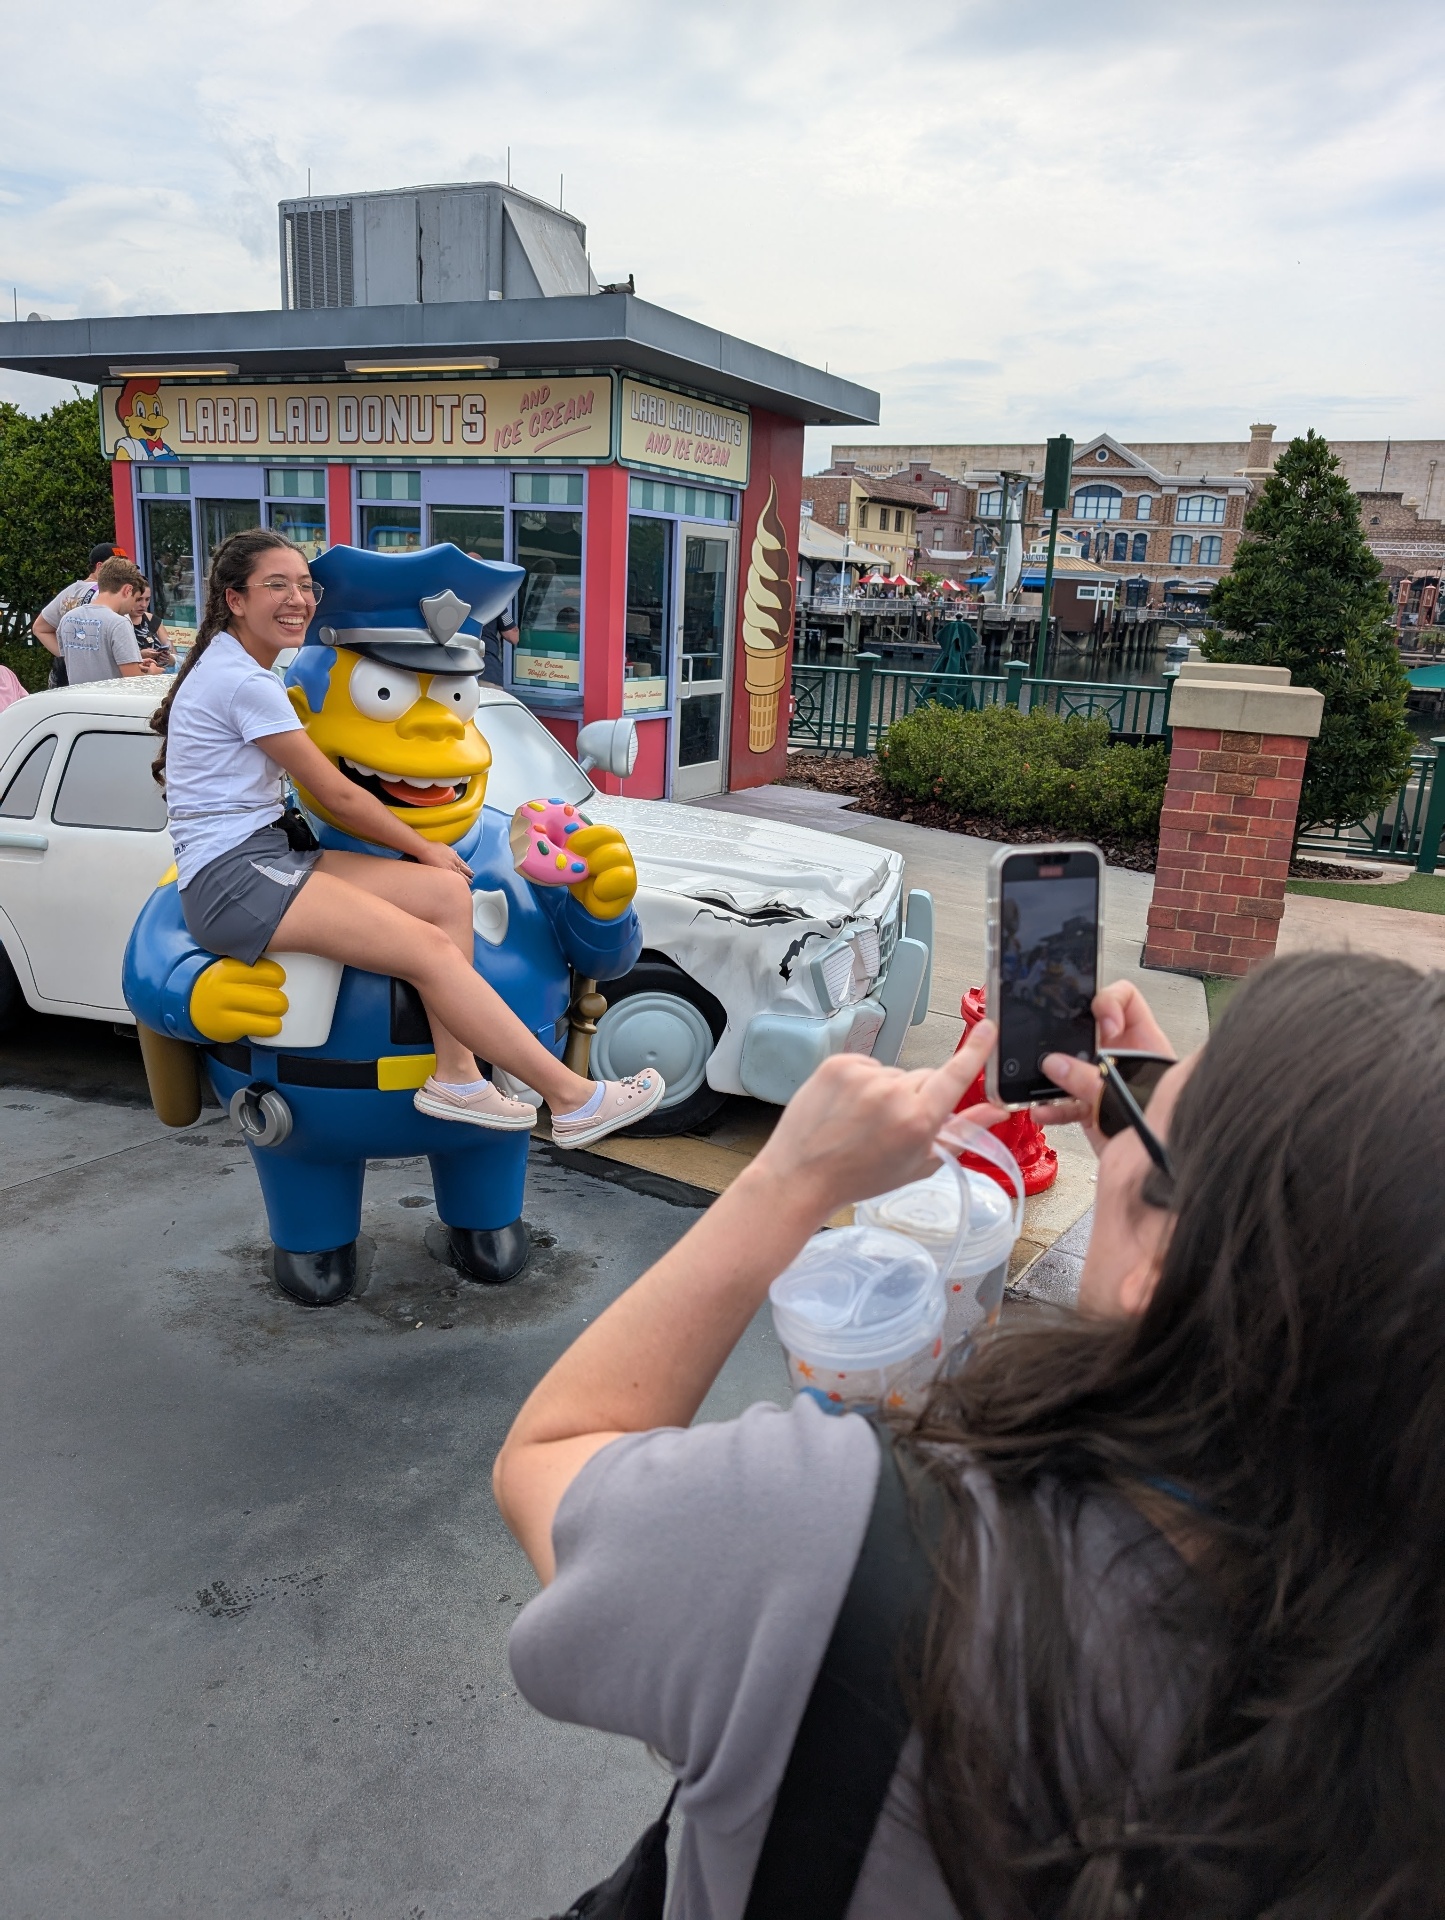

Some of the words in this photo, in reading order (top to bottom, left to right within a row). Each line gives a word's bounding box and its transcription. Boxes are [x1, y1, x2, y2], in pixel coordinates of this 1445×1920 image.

[519, 384, 551, 413] AND
[177, 397, 260, 444] LARD
[267, 396, 330, 444] LAD
[337, 394, 487, 444] DONUTS
[493, 418, 524, 453] ICE
[528, 389, 595, 438] CREAM
[631, 389, 666, 428] LARD
[669, 401, 693, 434] LAD
[695, 408, 743, 447] DONUTS
[645, 431, 671, 455] AND
[672, 436, 693, 460] ICE
[693, 441, 731, 467] CREAM
[527, 668, 547, 678] Waffle
[533, 659, 543, 667] Ice
[544, 660, 564, 669] Cream
